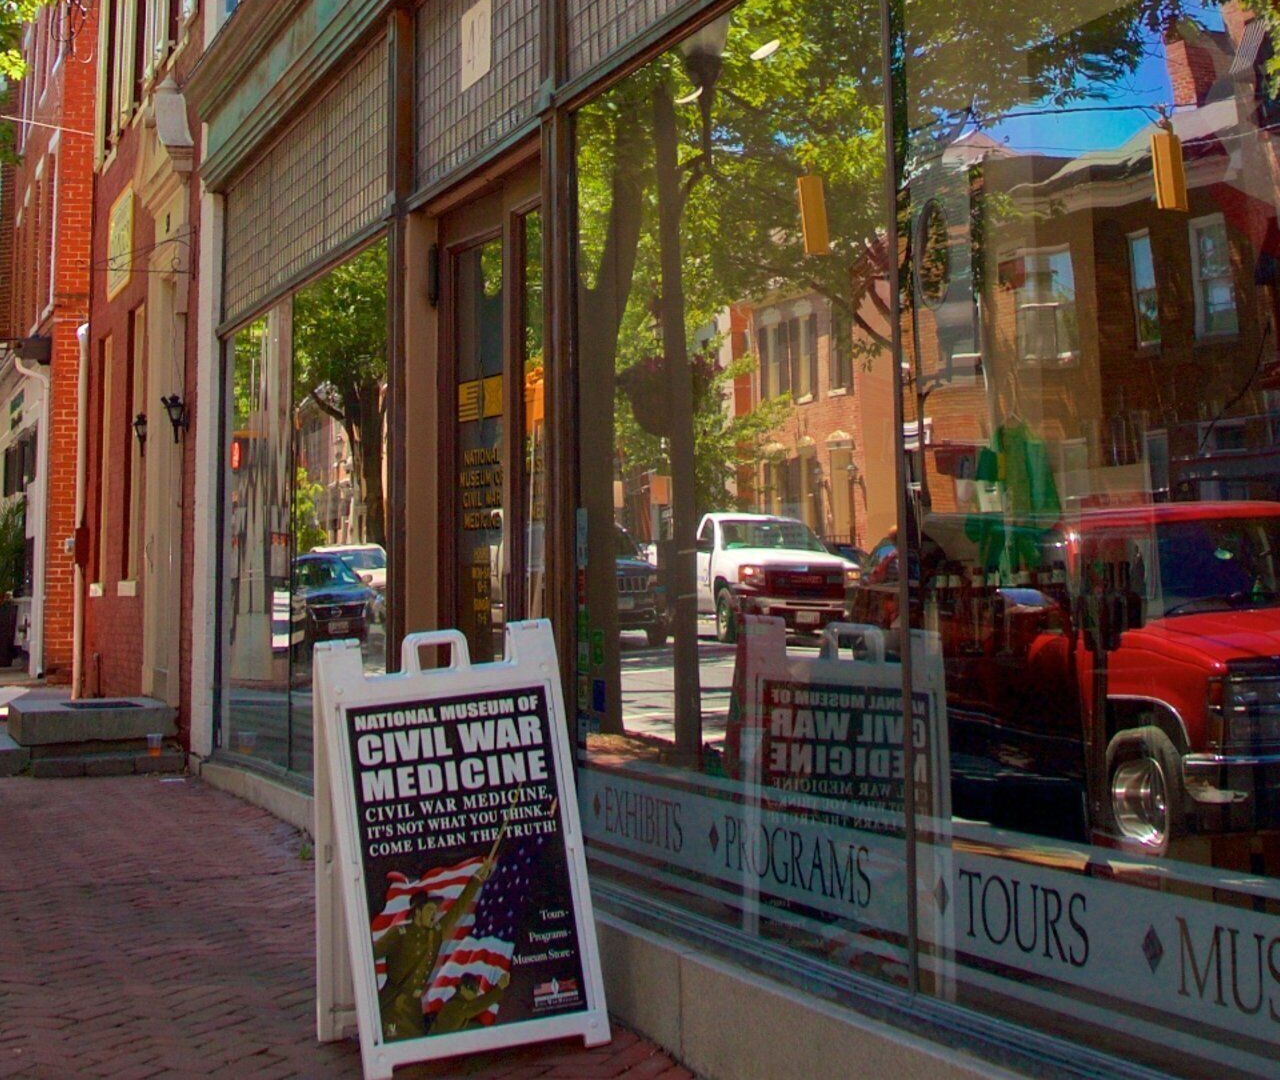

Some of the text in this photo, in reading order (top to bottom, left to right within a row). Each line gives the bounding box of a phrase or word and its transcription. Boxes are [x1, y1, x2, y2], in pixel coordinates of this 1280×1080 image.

[354, 695, 538, 732] NATIONAL MUSEUM OF
[357, 715, 543, 767] CIVIL WAR
[360, 749, 548, 803] MEDICINE
[365, 785, 553, 822] CIVIL WAR MEDICINE,
[367, 823, 394, 839] IT'S
[397, 819, 425, 836] NOT
[428, 814, 467, 831] WHAT
[470, 809, 498, 827] YOU
[604, 785, 684, 854] EXHIBITS
[369, 819, 557, 857] COME LEARN THE TRUTH!
[724, 814, 872, 909] PROGRAMS
[540, 909, 565, 920] Tours
[958, 867, 1091, 968] TOURS
